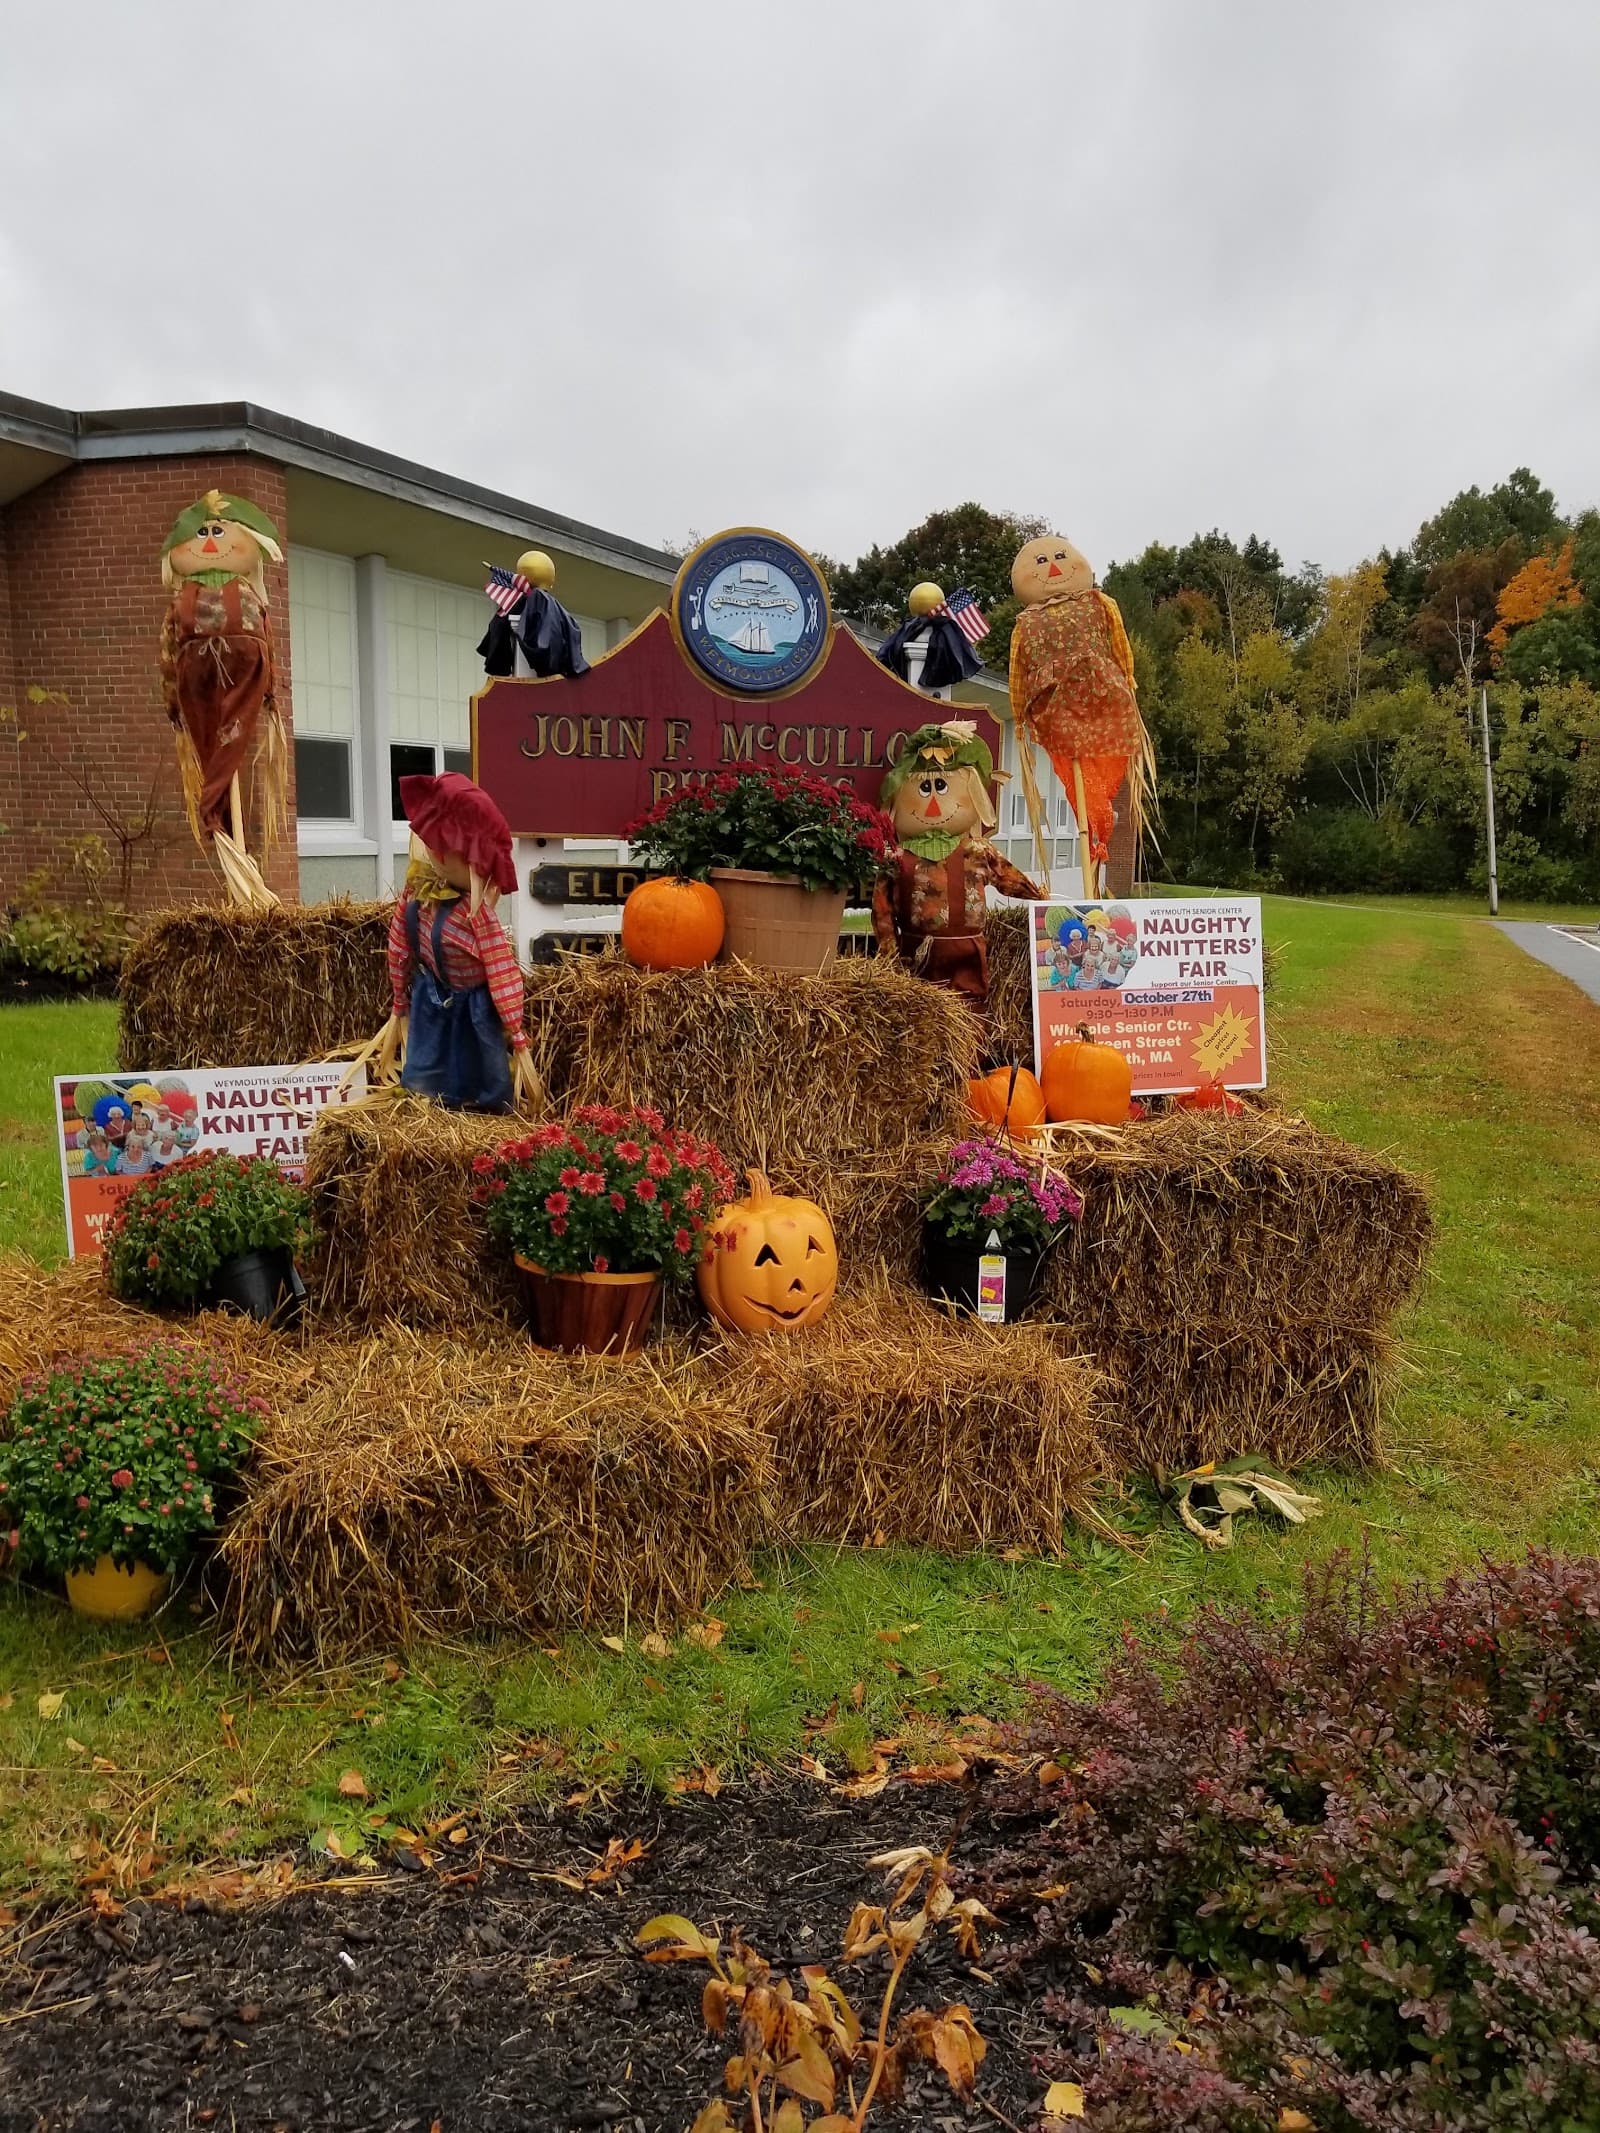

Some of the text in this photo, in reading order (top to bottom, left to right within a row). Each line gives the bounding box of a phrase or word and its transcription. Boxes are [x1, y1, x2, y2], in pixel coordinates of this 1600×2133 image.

[521, 714, 908, 768] JOHN F. McCULLO
[568, 871, 658, 897] ELD
[1143, 917, 1252, 935] NAUGHTY
[1140, 938, 1257, 957] KNITTERS'
[1179, 961, 1228, 978] FAIR
[1215, 978, 1238, 986] Center
[1060, 990, 1212, 1009] Saturday, October 27th
[1115, 1021, 1163, 1034] Senior
[1166, 1019, 1193, 1031] Ctr.
[1136, 1035, 1181, 1048] Street
[1150, 1050, 1174, 1064] MA
[214, 1074, 340, 1088] WEYMOUTH SENIOR CENTER
[206, 1084, 352, 1110] NAUGHTY
[202, 1112, 314, 1135] KNITTE
